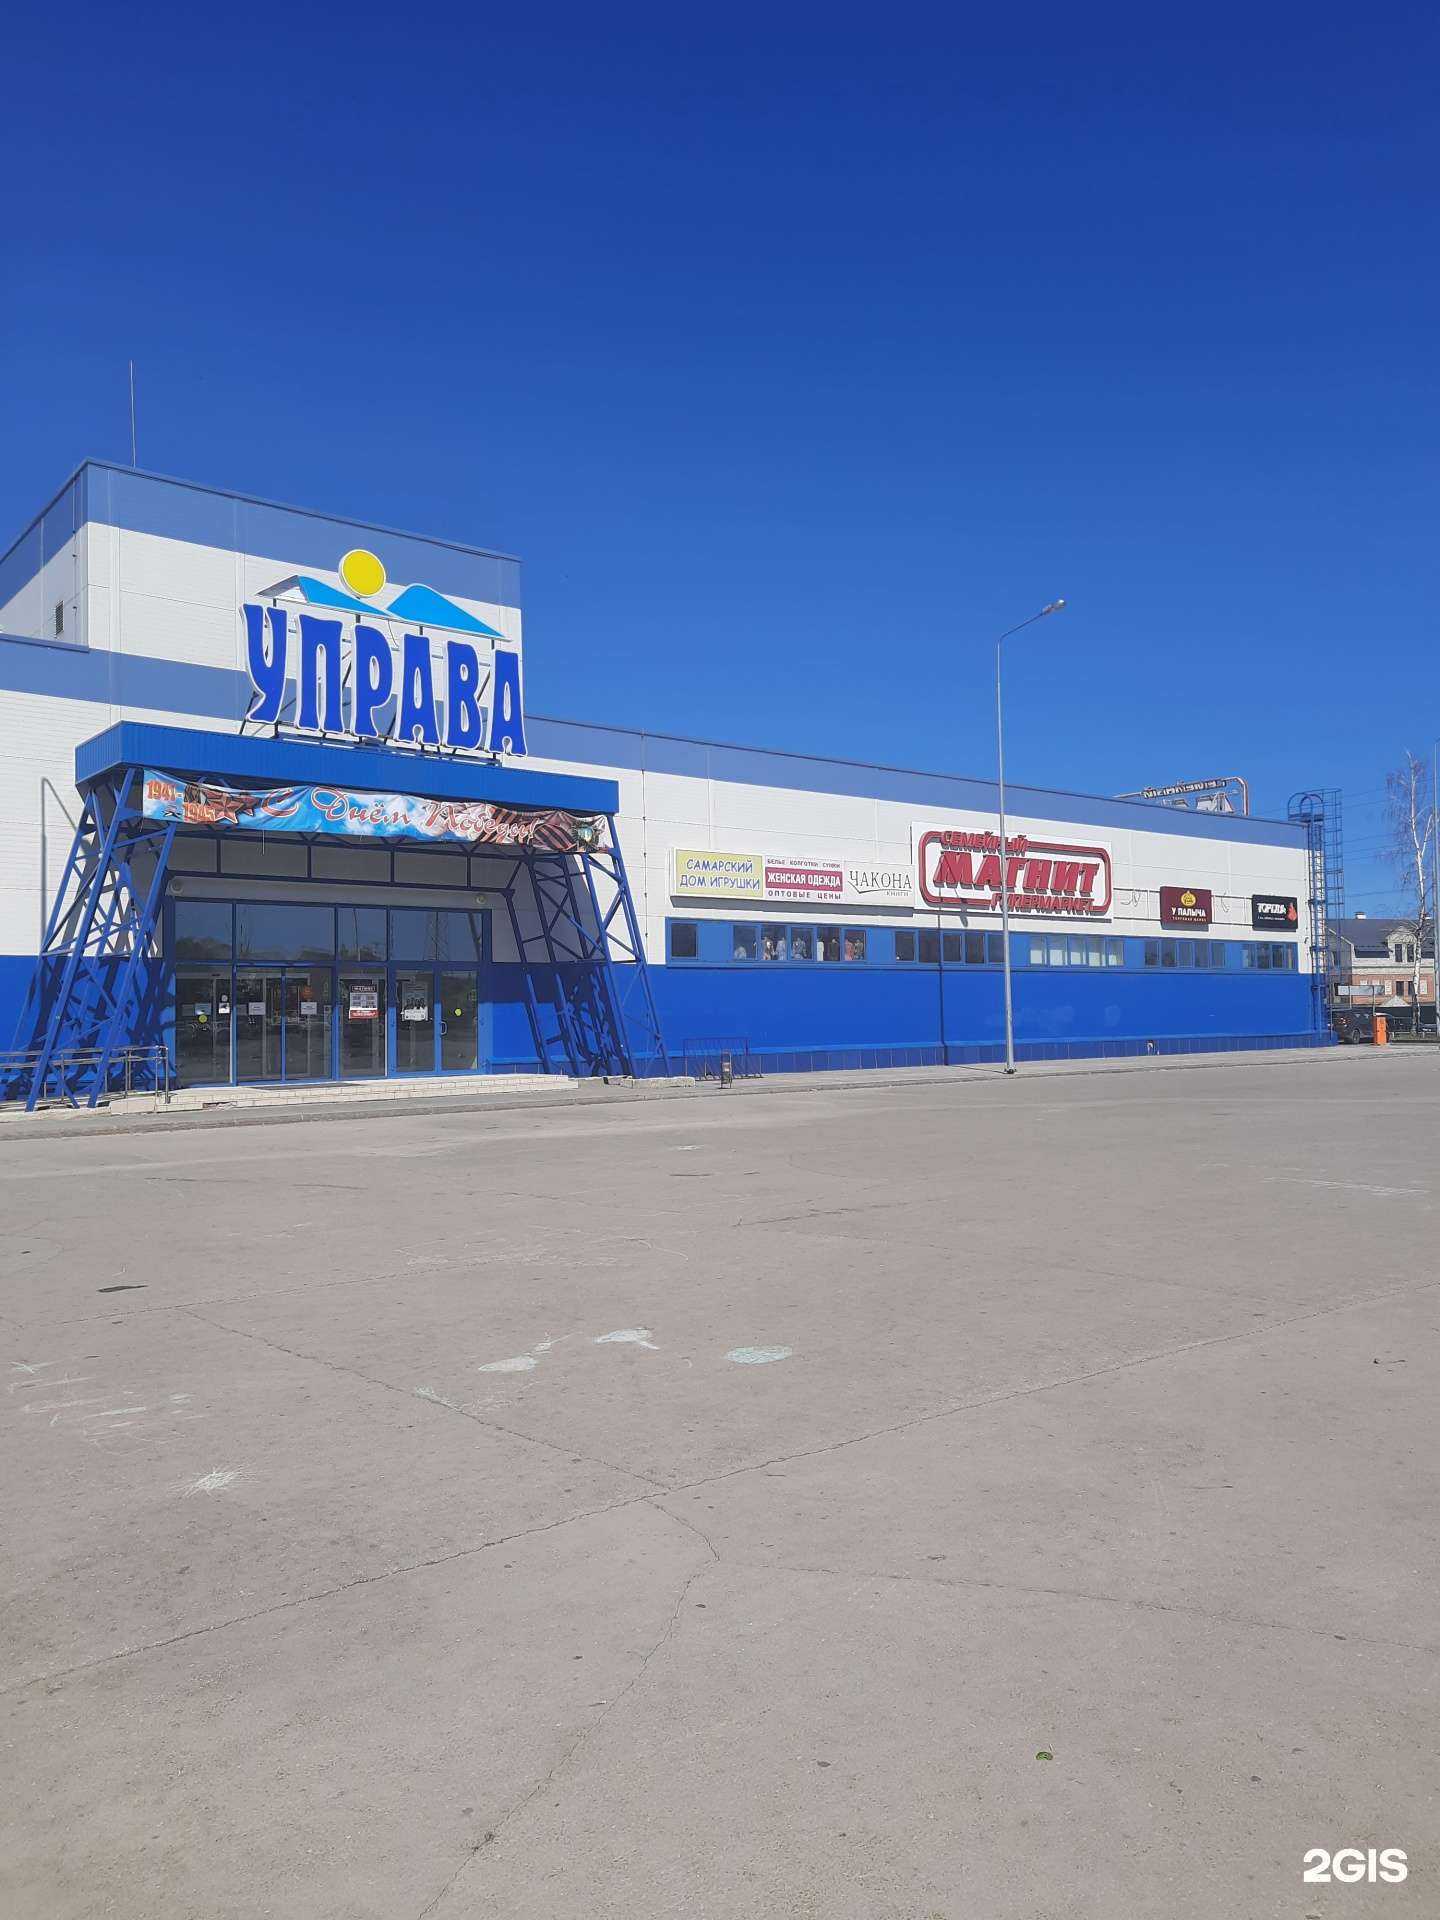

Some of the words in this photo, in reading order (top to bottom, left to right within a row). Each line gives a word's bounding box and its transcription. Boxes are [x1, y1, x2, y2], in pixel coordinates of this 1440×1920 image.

[240, 603, 527, 757] УПРАВА
[311, 786, 411, 826] Днём
[686, 858, 754, 874] САМАРСКИЙ
[933, 851, 1100, 896] МАГНИТ
[680, 874, 707, 888] ДОМ
[710, 875, 760, 891] ИГРУШКИ
[767, 872, 806, 884] ЖЕНСКАЯ
[808, 874, 841, 887] ОДЕЖДА
[849, 870, 912, 889] ЧАКОНА
[768, 890, 811, 898] ОПТОВЫЕ
[817, 892, 841, 900] ЦЕНЫ
[1171, 907, 1176, 915] У
[1177, 907, 1207, 917] ПАЛЫЧА
